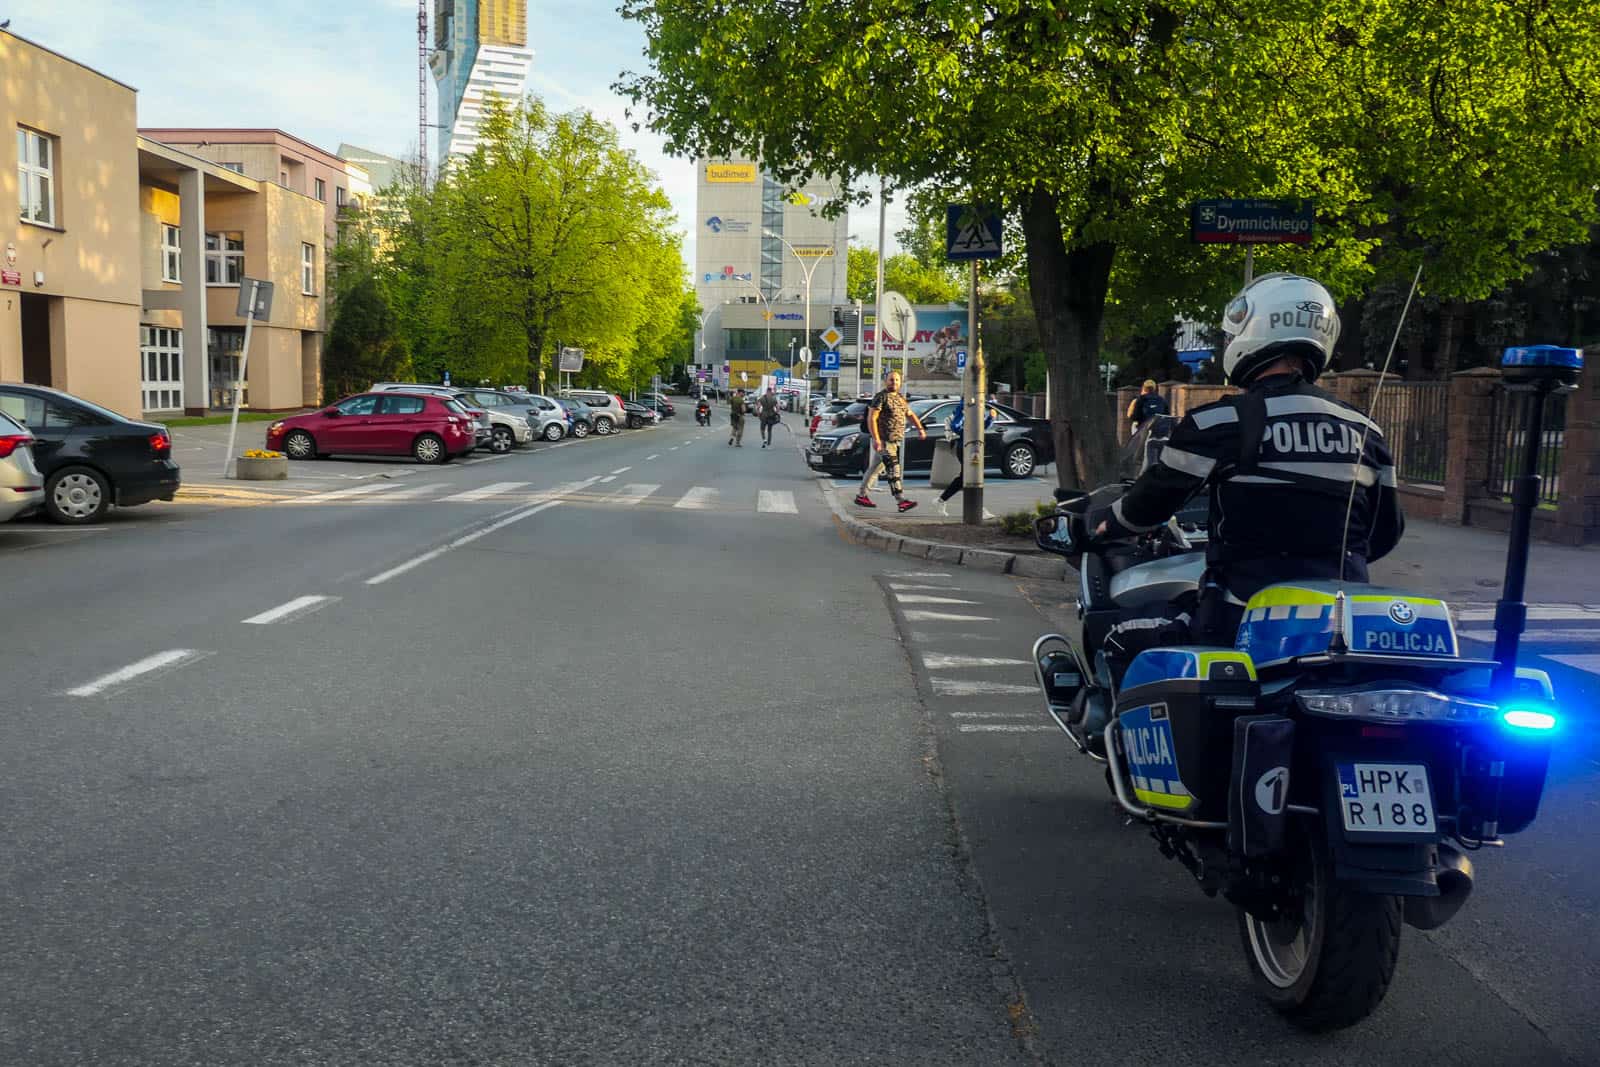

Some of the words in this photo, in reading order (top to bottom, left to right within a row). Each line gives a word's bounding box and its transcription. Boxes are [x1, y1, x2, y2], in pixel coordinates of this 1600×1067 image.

[1217, 215, 1309, 233] Dymnickiego
[1269, 311, 1335, 337] POLICJA
[825, 353, 836, 368] P
[1366, 630, 1448, 653] POLICJA
[1343, 783, 1357, 794] PL
[1359, 770, 1412, 793] HPK
[1349, 802, 1428, 826] R188
